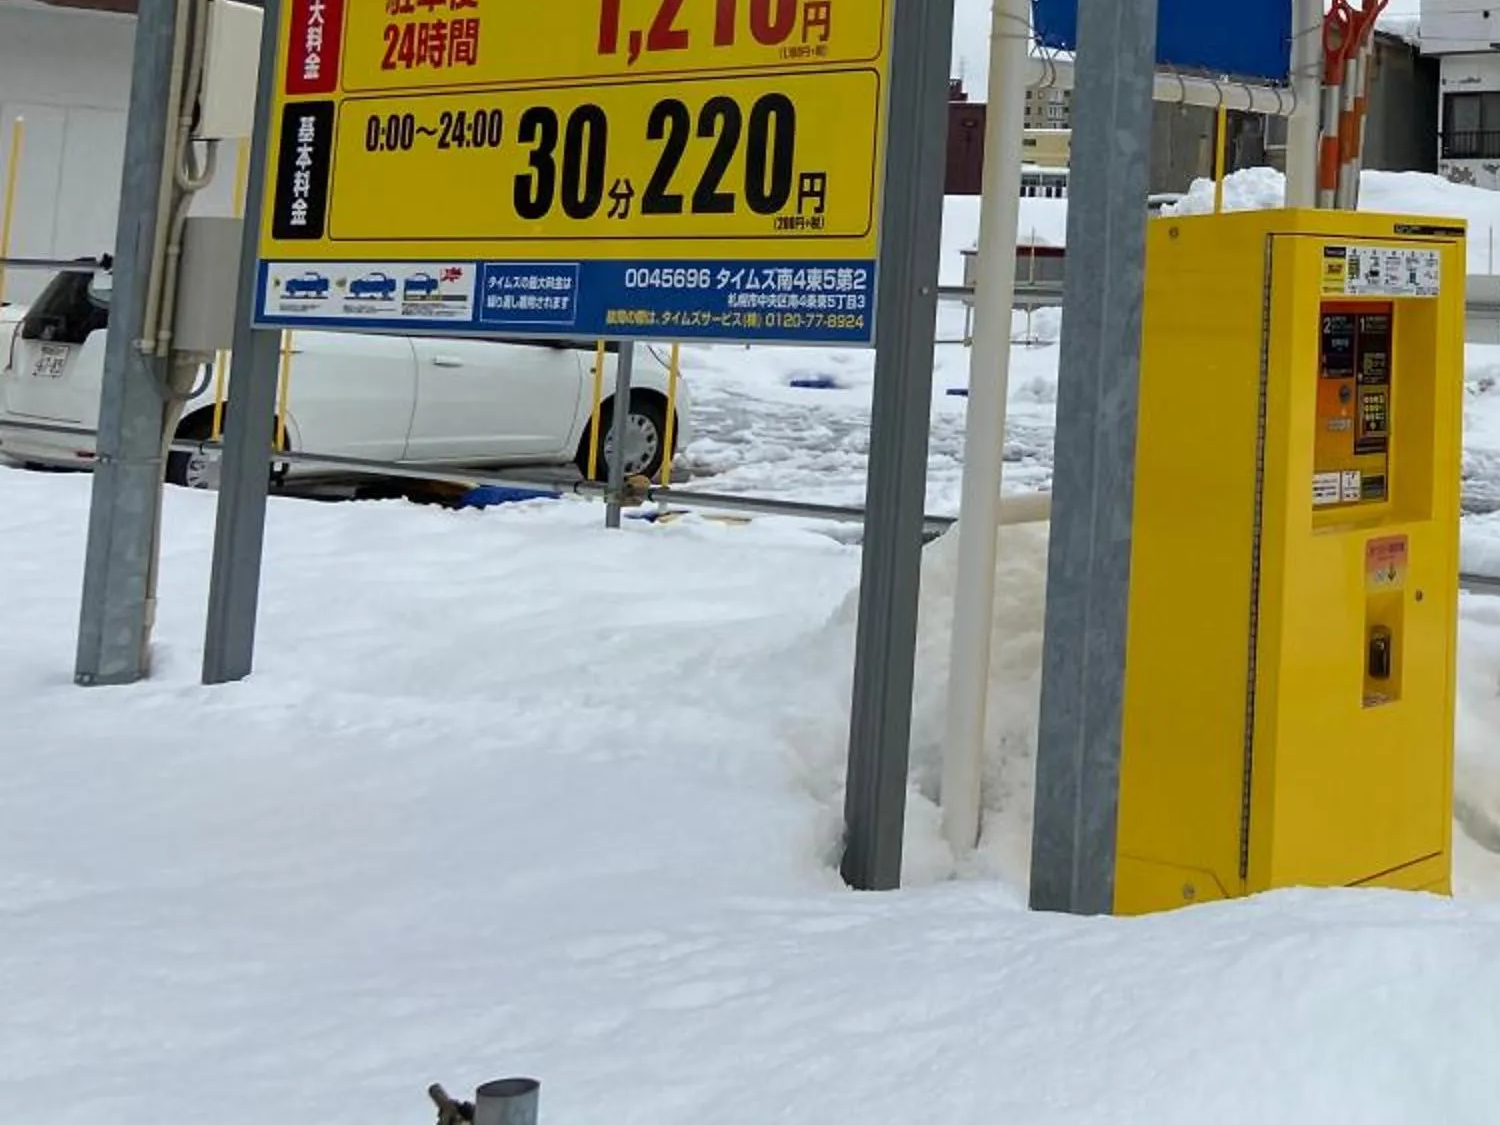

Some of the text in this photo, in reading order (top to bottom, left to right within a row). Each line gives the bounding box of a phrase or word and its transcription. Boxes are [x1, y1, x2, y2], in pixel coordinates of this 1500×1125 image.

[380, 17, 481, 71] 24時間
[290, 115, 317, 226] 基本料金
[624, 268, 712, 289] 0045696
